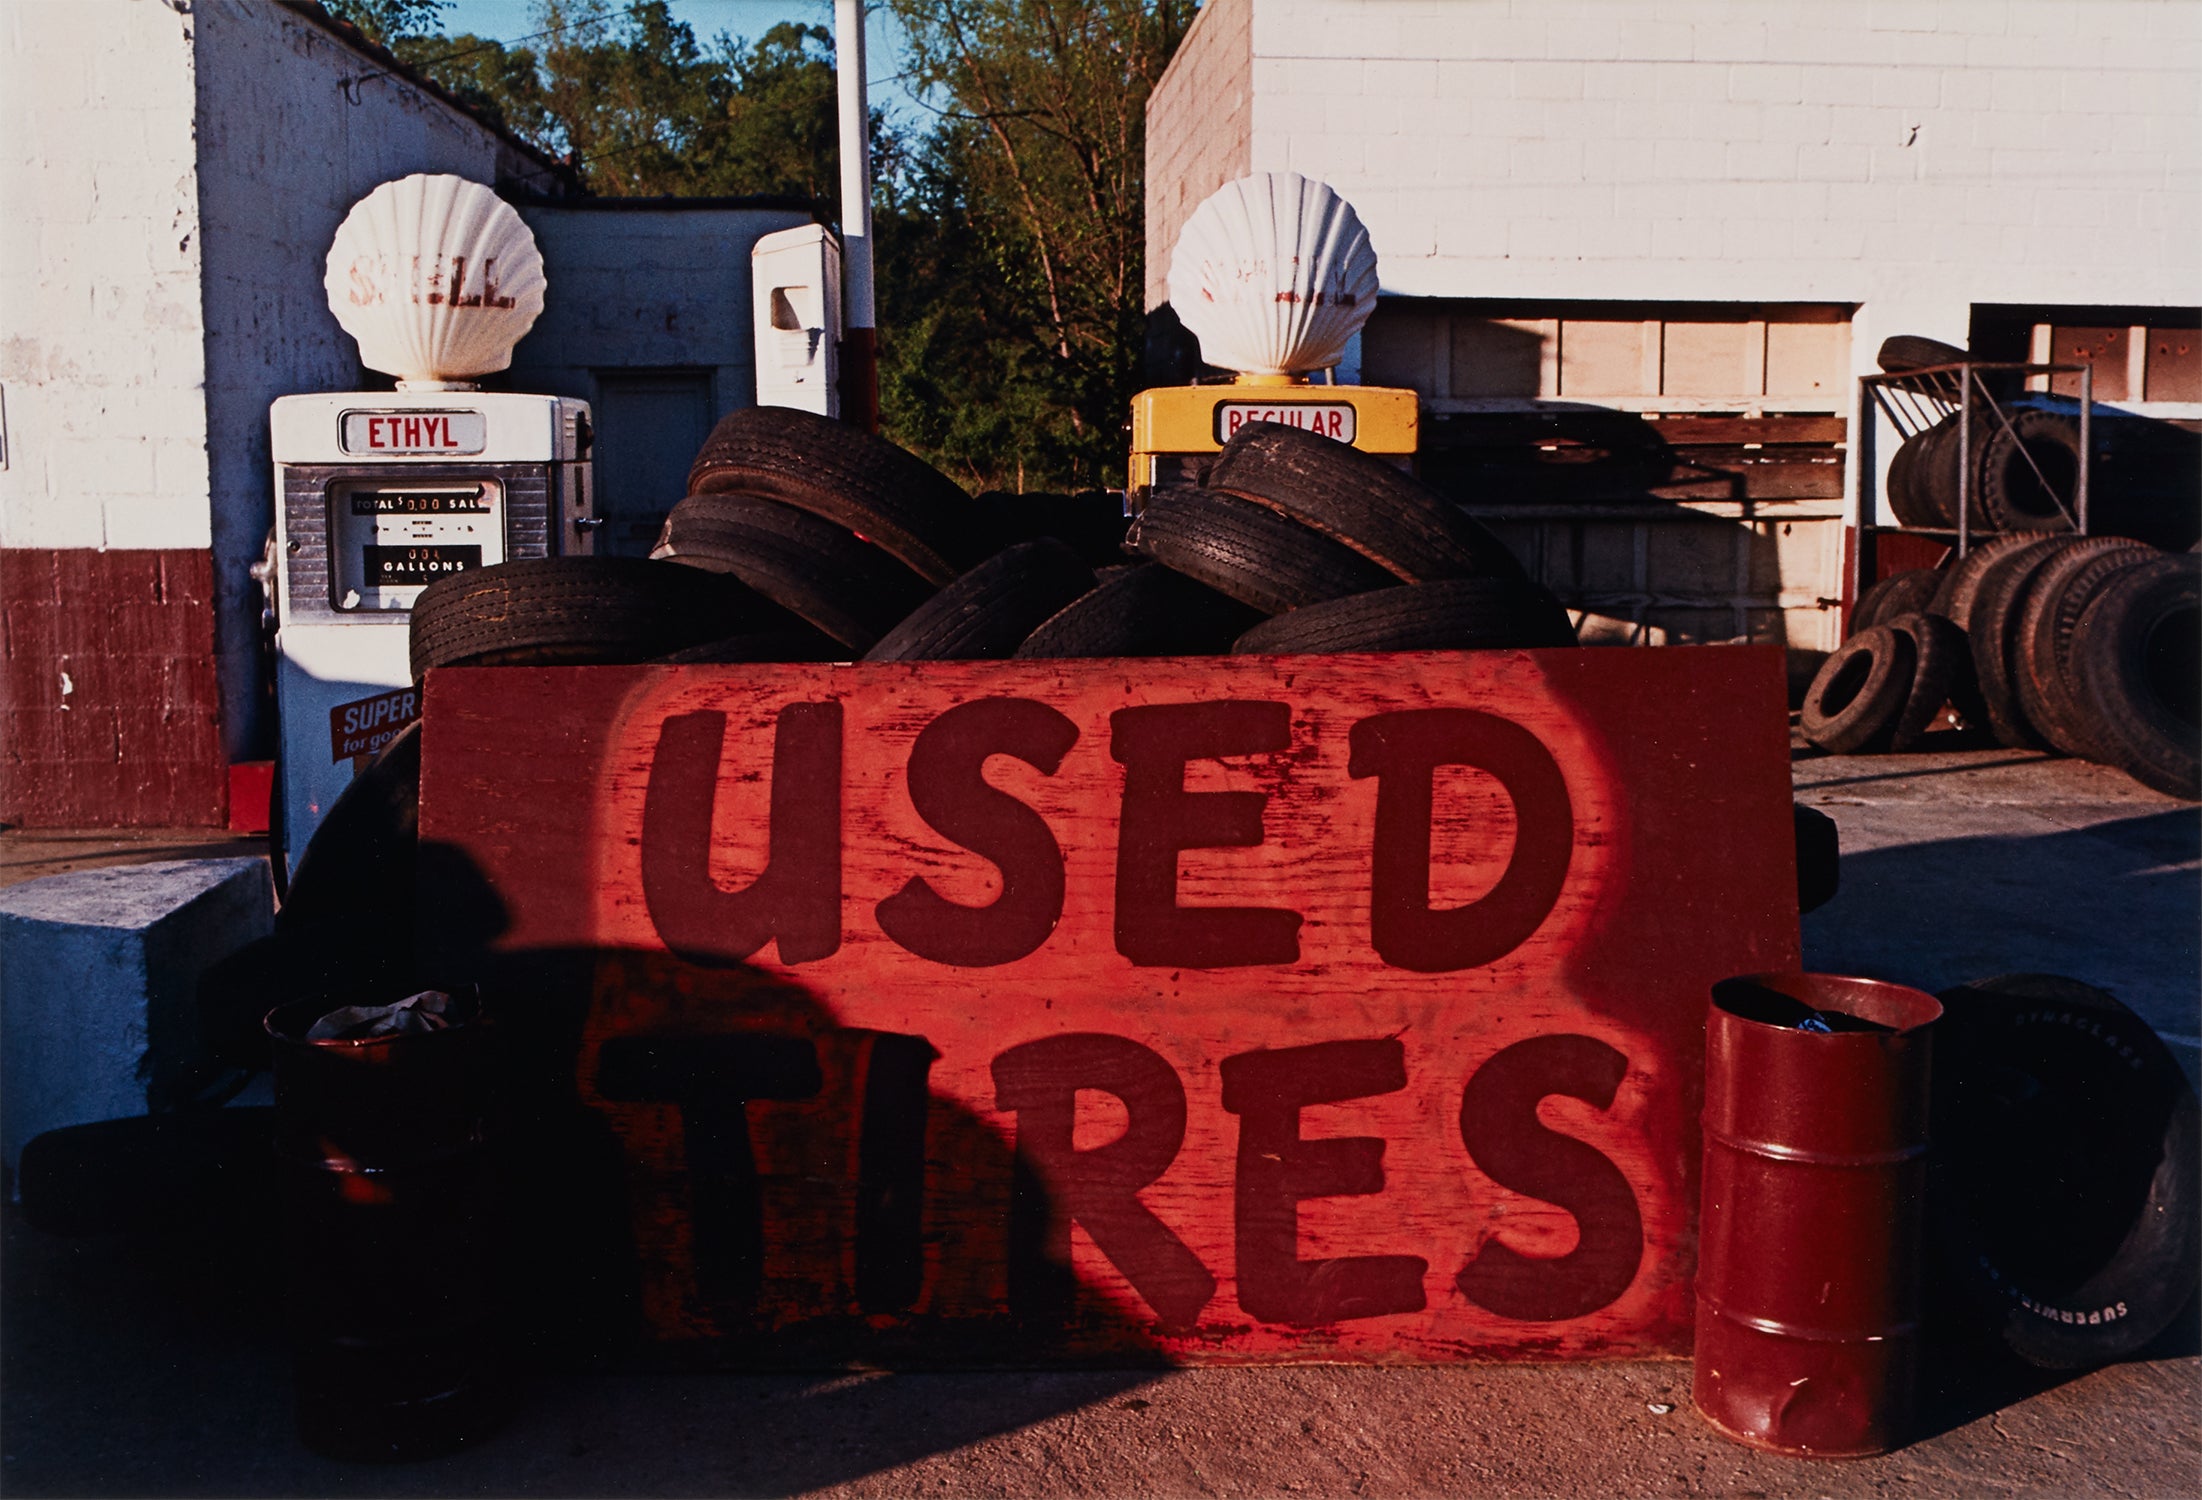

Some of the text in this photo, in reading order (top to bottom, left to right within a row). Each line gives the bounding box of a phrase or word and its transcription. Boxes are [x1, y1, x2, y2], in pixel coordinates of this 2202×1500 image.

[350, 254, 516, 307] SLL
[368, 417, 458, 448] ETHYL
[449, 499, 476, 510] SAL
[383, 561, 465, 572] GALLONS
[343, 692, 416, 735] SUPER
[343, 728, 403, 754] for goo
[641, 697, 1575, 973] USED
[600, 1027, 1645, 1328] TIRES
